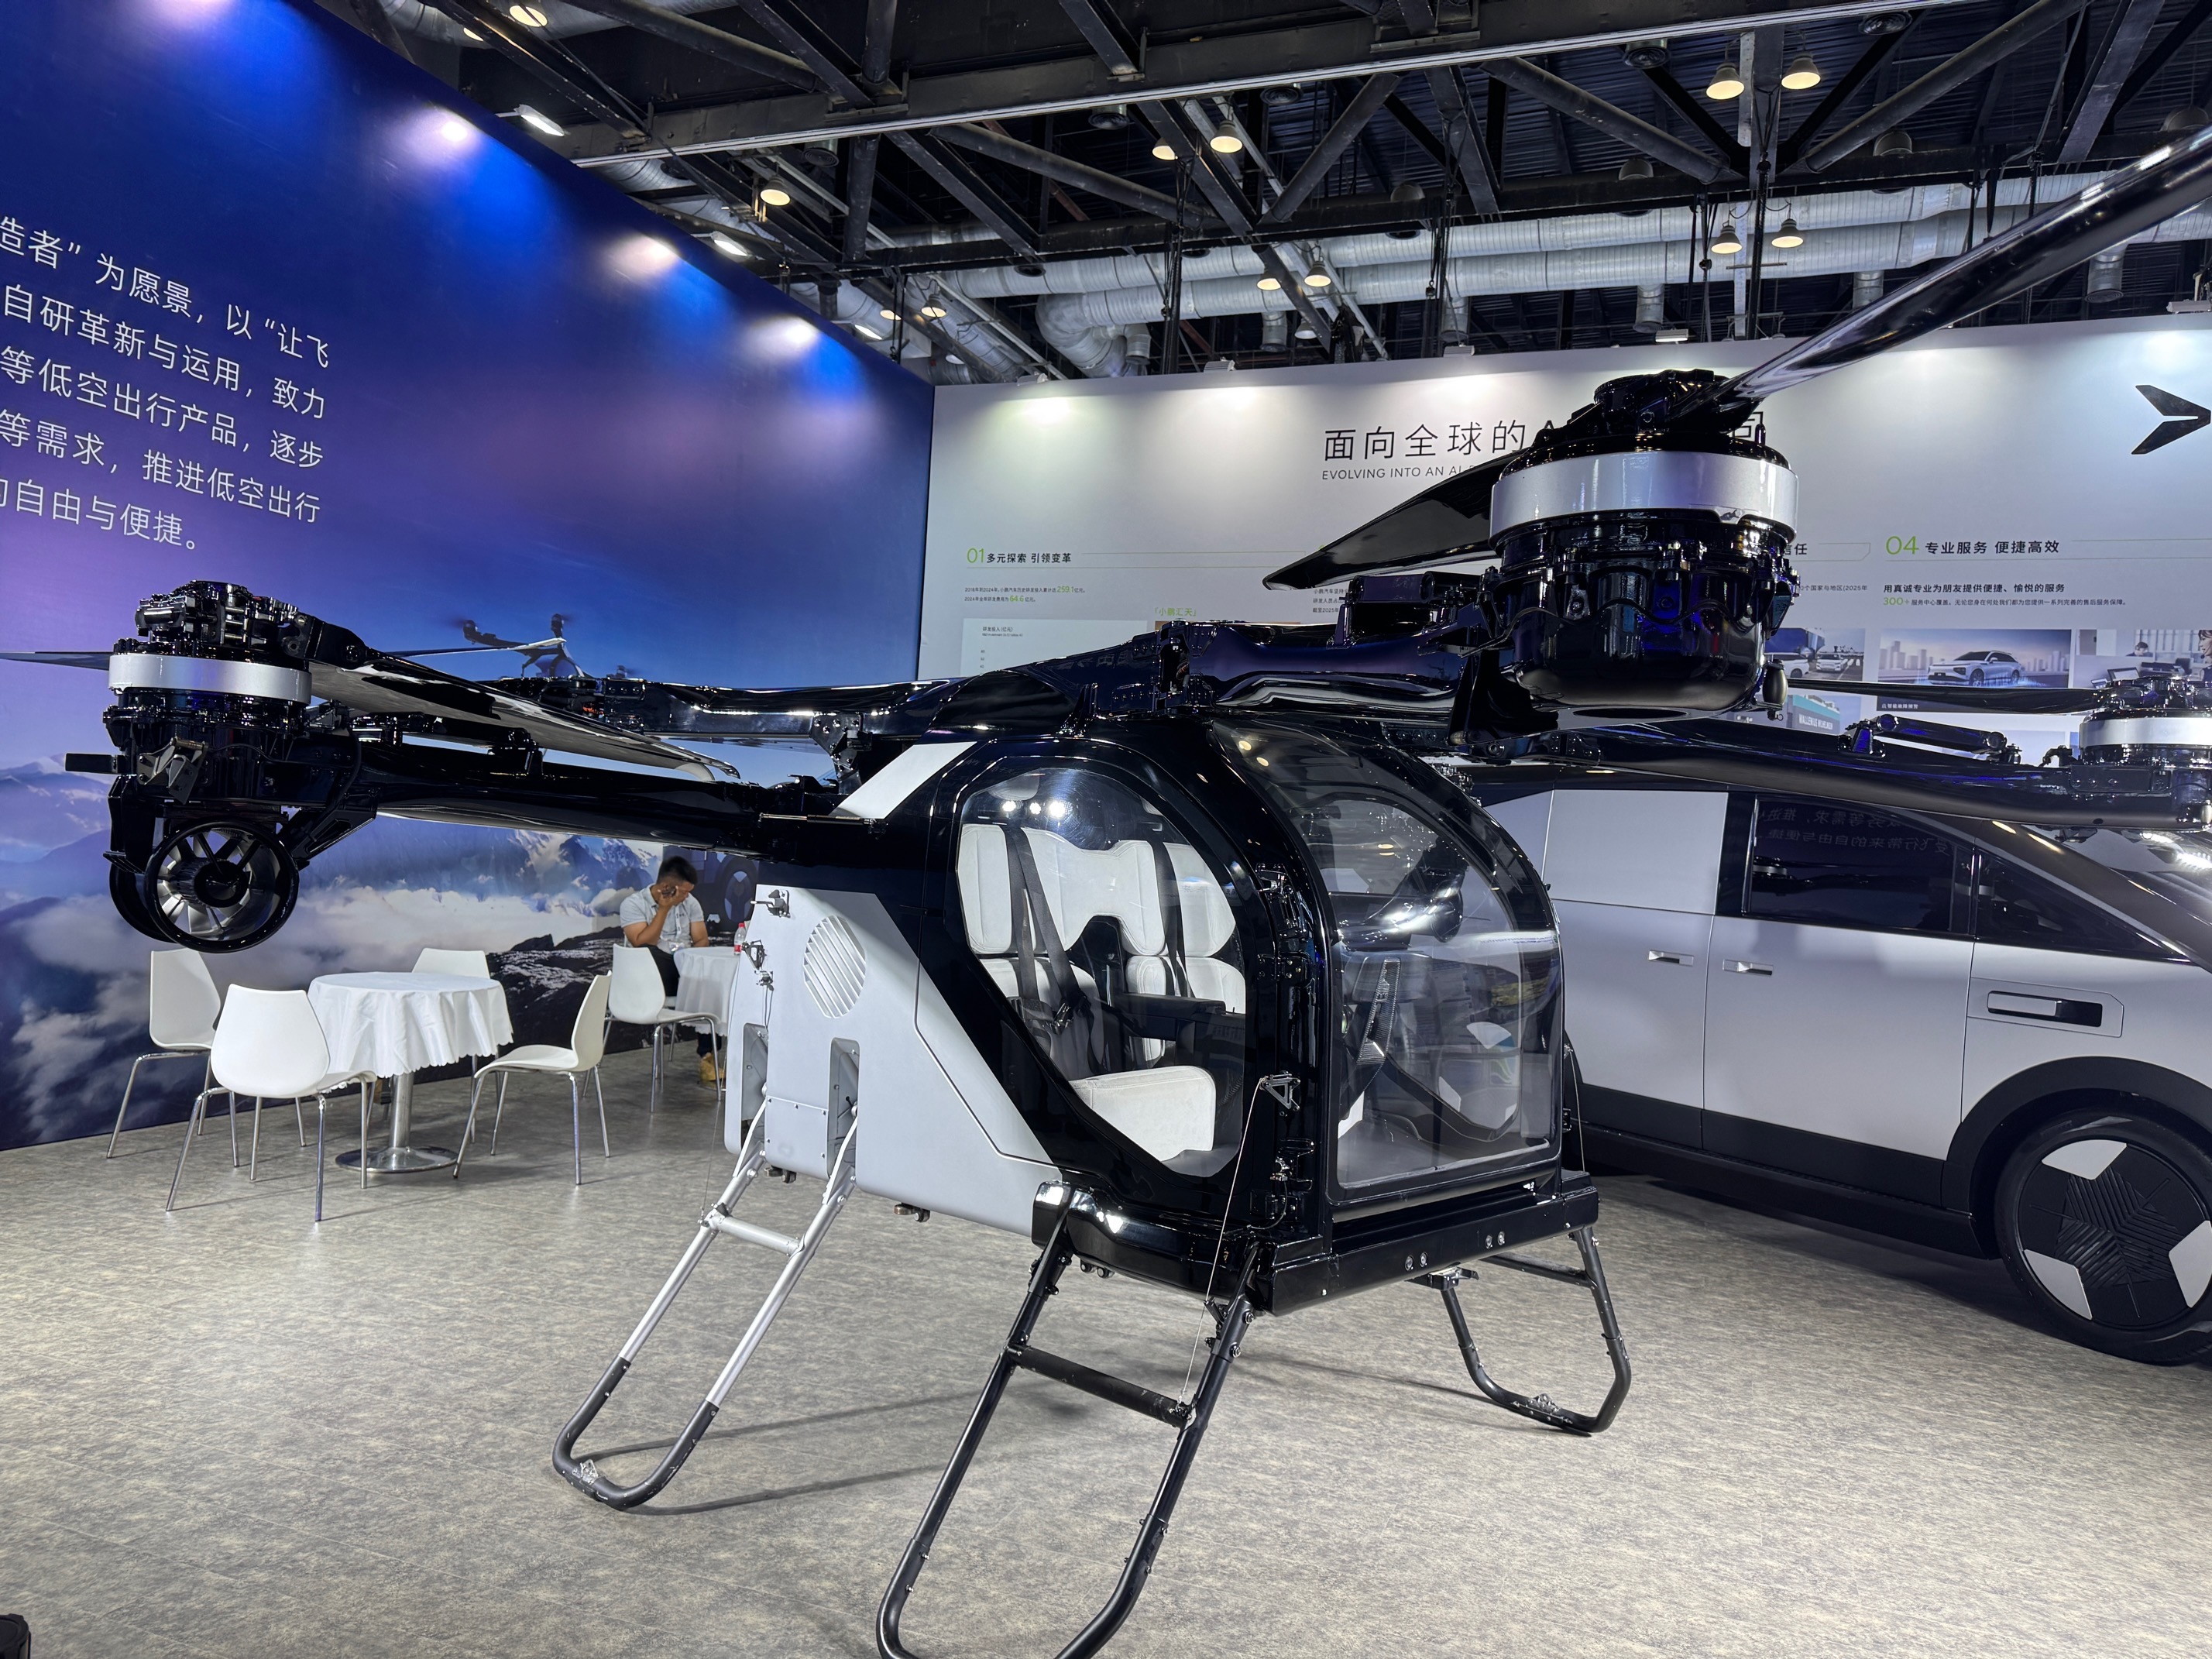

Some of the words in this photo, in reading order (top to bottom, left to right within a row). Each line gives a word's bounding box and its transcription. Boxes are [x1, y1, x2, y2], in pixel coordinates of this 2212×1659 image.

[1322, 467, 1386, 480] EVOLVING
[1390, 466, 1421, 478] INTO
[1425, 466, 1444, 476] AN
[1886, 536, 1918, 555] 04
[1925, 541, 1987, 555] 专业服务
[1994, 540, 2060, 555] 便捷高效
[967, 548, 984, 564] 01
[987, 553, 1027, 564] 多元探索
[1031, 553, 1071, 564] 引领变革
